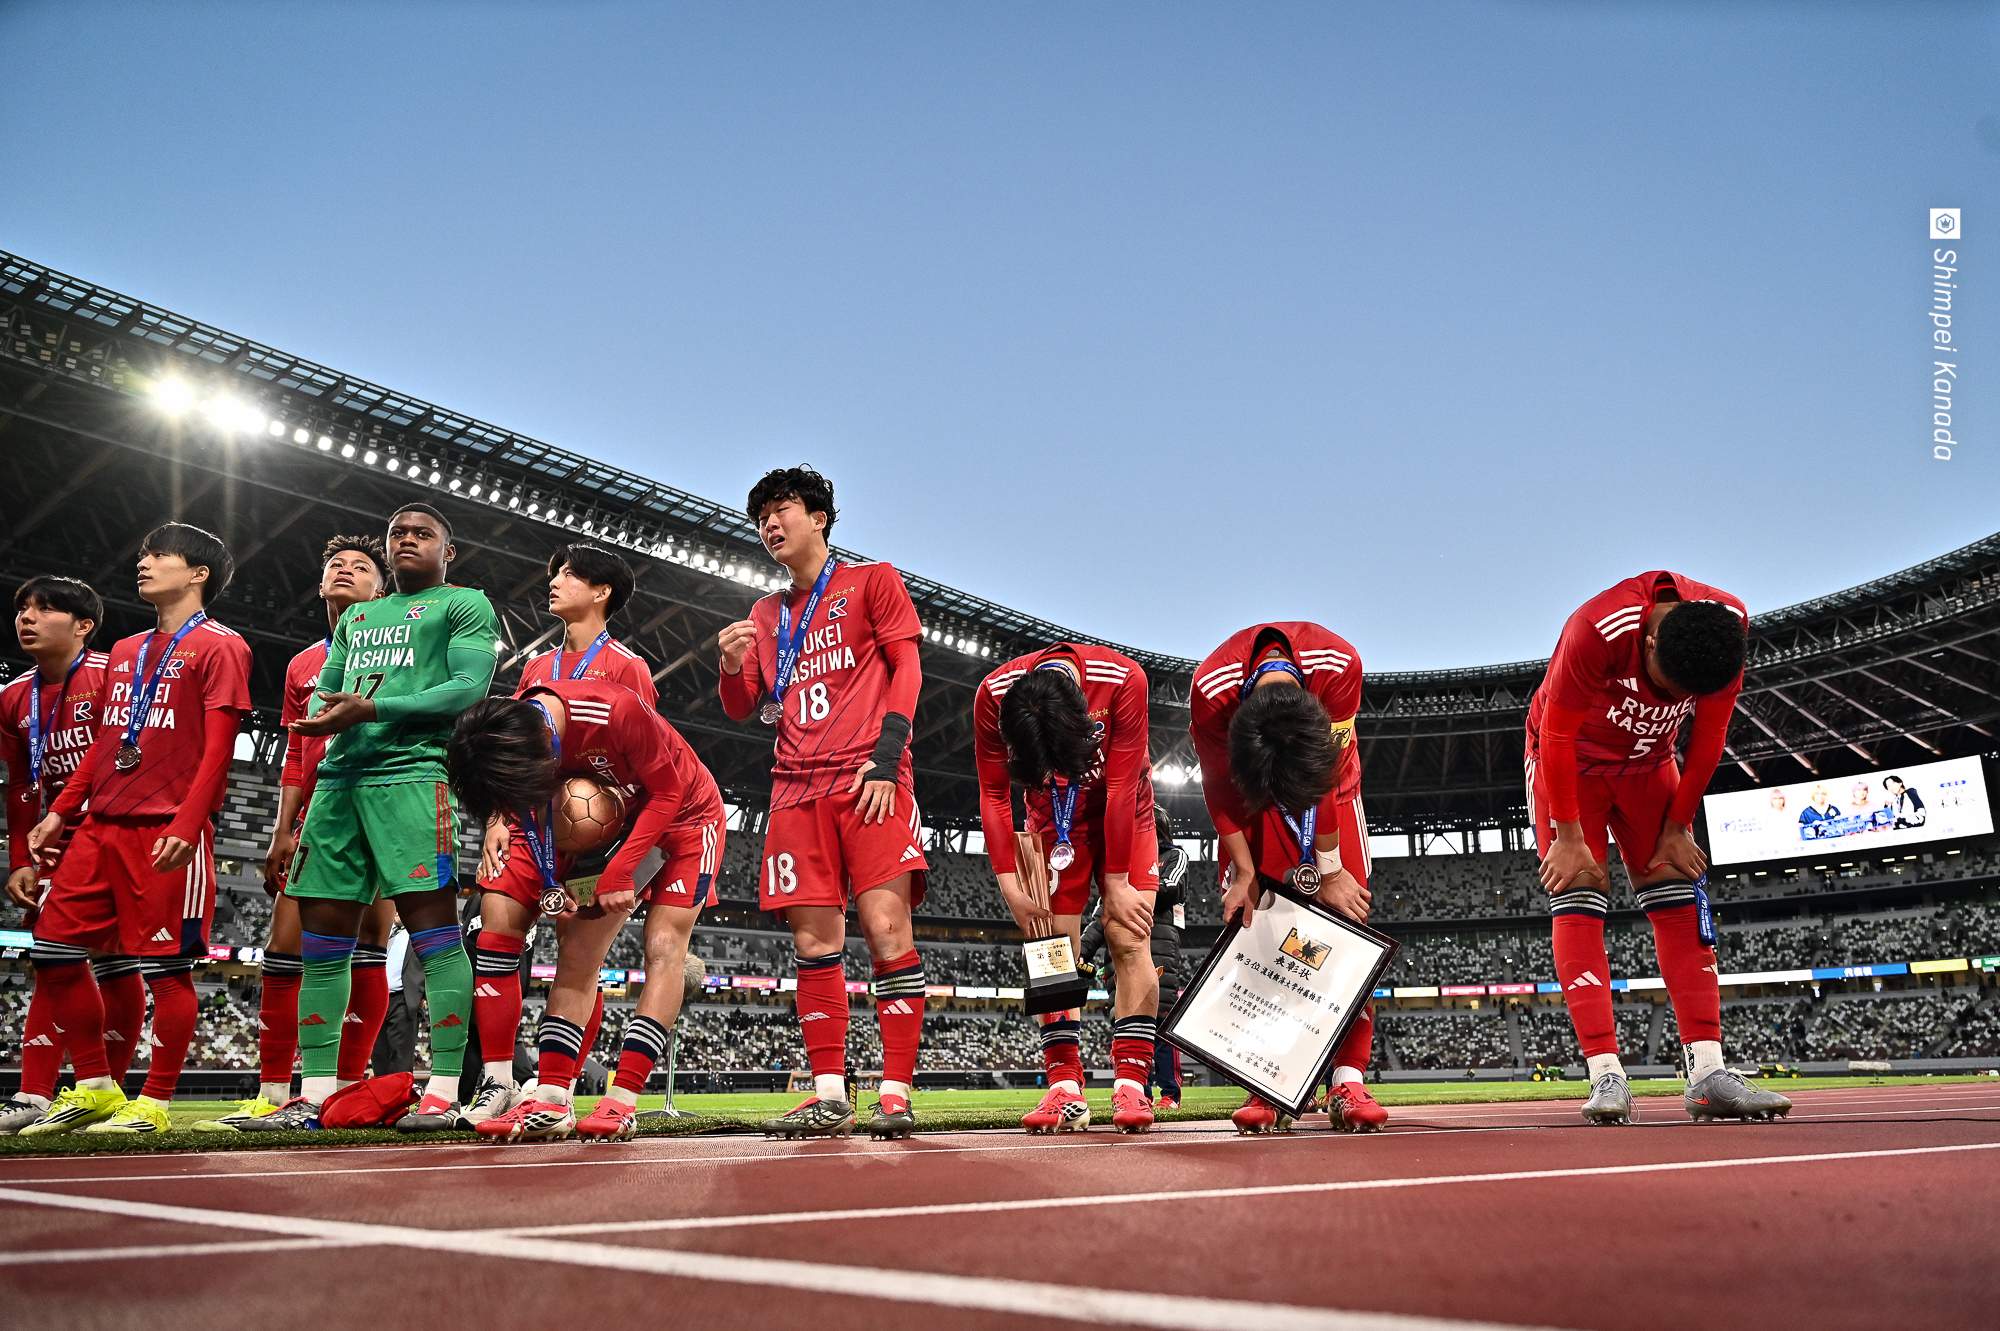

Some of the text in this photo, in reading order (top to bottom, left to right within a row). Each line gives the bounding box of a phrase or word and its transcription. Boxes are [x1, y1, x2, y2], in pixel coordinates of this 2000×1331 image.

[351, 624, 411, 649] RYUKEI
[797, 622, 843, 658] UKEI
[345, 647, 415, 672] KASHIWA
[784, 646, 856, 688] ASHIWA
[111, 682, 171, 704] RYEI
[353, 672, 386, 700] 17
[798, 681, 831, 726] 18
[1621, 695, 1694, 721] RYUKE
[102, 705, 175, 730] KASIWA
[43, 725, 95, 753] UKEI
[1629, 738, 1657, 759] 5
[766, 852, 799, 897] 18
[1273, 955, 1312, 981] 表彰状
